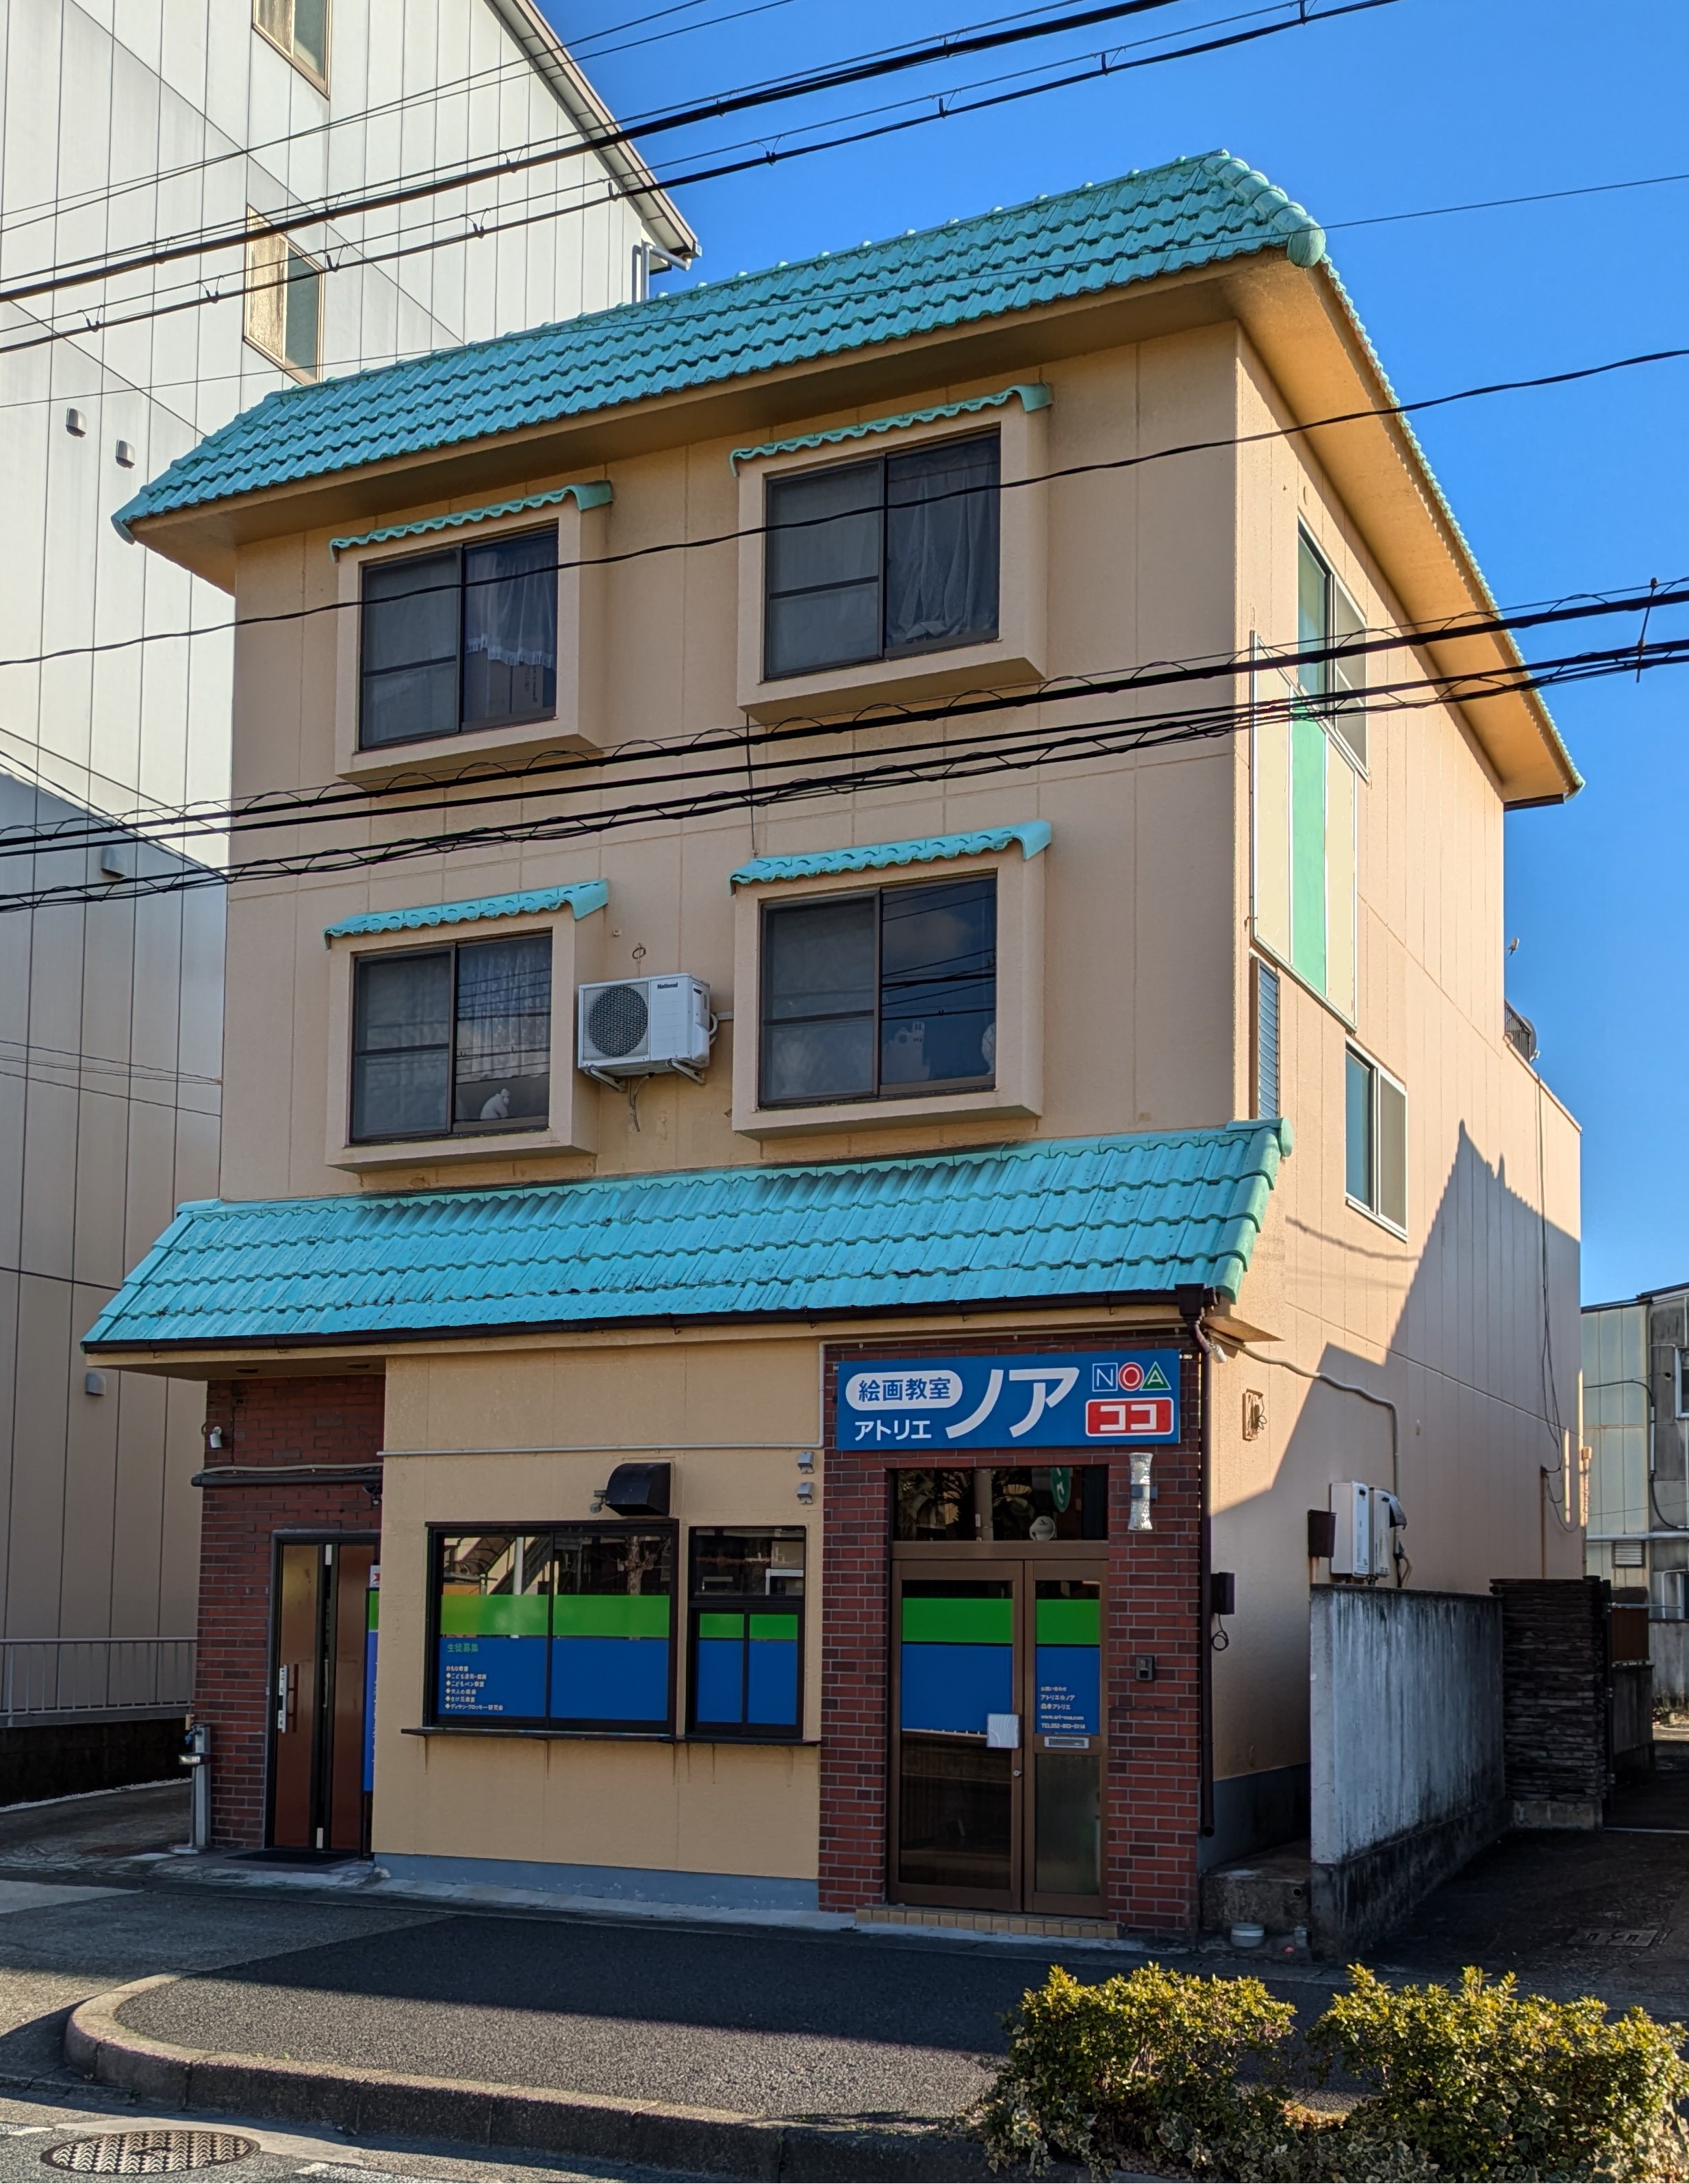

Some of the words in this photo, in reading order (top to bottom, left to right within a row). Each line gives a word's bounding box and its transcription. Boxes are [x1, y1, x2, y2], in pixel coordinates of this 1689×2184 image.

[859, 1377, 951, 1402] 絵画教室
[1095, 1364, 1163, 1389] NOA
[854, 1419, 932, 1441] アトリエ
[945, 1367, 1080, 1438] ノア
[1100, 1404, 1158, 1431] ココ
